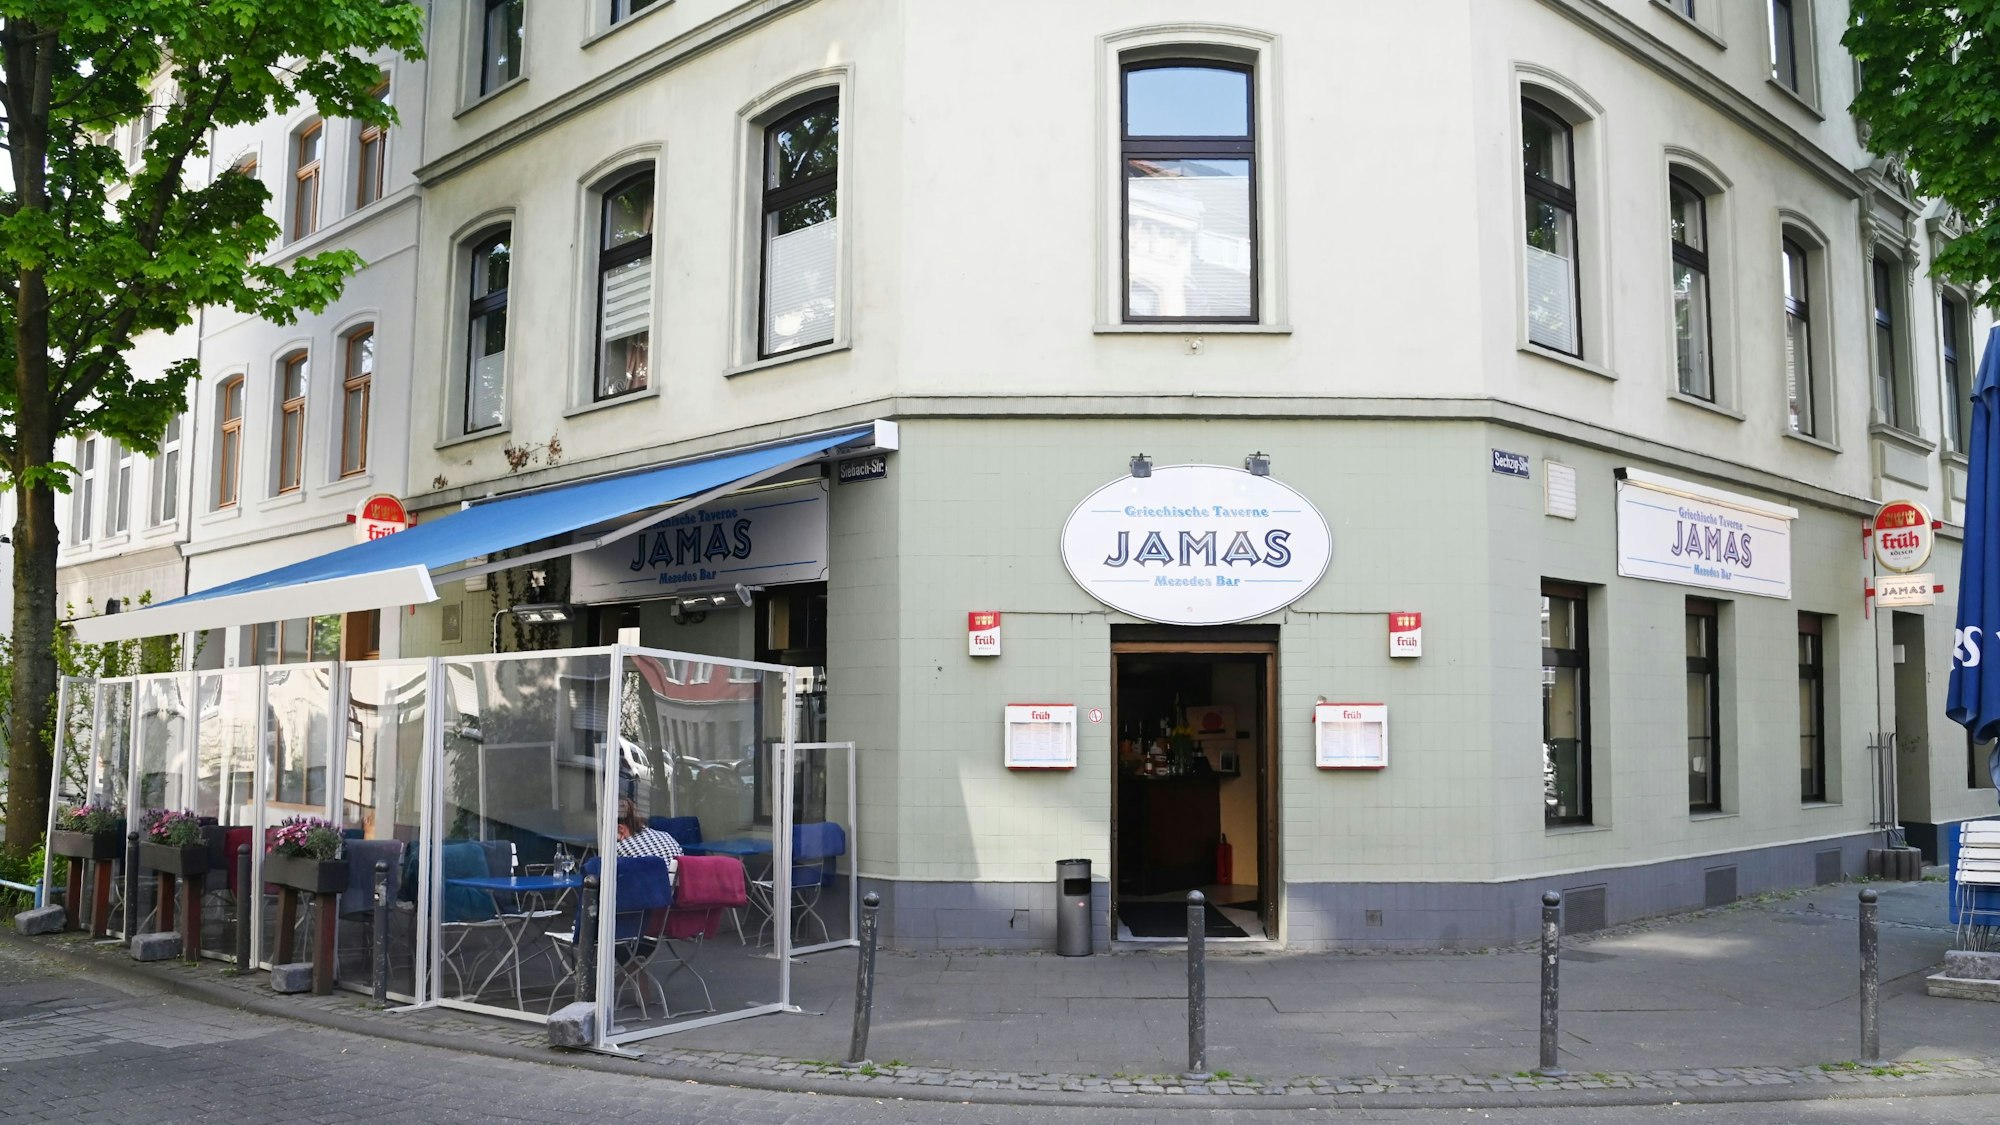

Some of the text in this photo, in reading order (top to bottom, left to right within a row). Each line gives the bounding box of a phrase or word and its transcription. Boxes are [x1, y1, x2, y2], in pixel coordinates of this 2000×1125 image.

[698, 508, 738, 523] Taverne
[1124, 505, 1270, 518] Griechische Taverne
[1678, 506, 1744, 531] Griechische Taverne
[629, 518, 752, 572] JAMAS
[1671, 520, 1753, 569] JAMAS
[1881, 531, 1920, 550] früh
[1103, 529, 1293, 569] JAMAS
[659, 569, 718, 585] Mezedes Bar
[1720, 568, 1733, 580] Bar
[1154, 575, 1242, 587] Mezedes Bar
[1881, 585, 1927, 597] JAMAS
[974, 635, 996, 646] früh
[1397, 636, 1418, 648] früh
[1031, 710, 1051, 721] früh
[1343, 710, 1363, 720] früh
